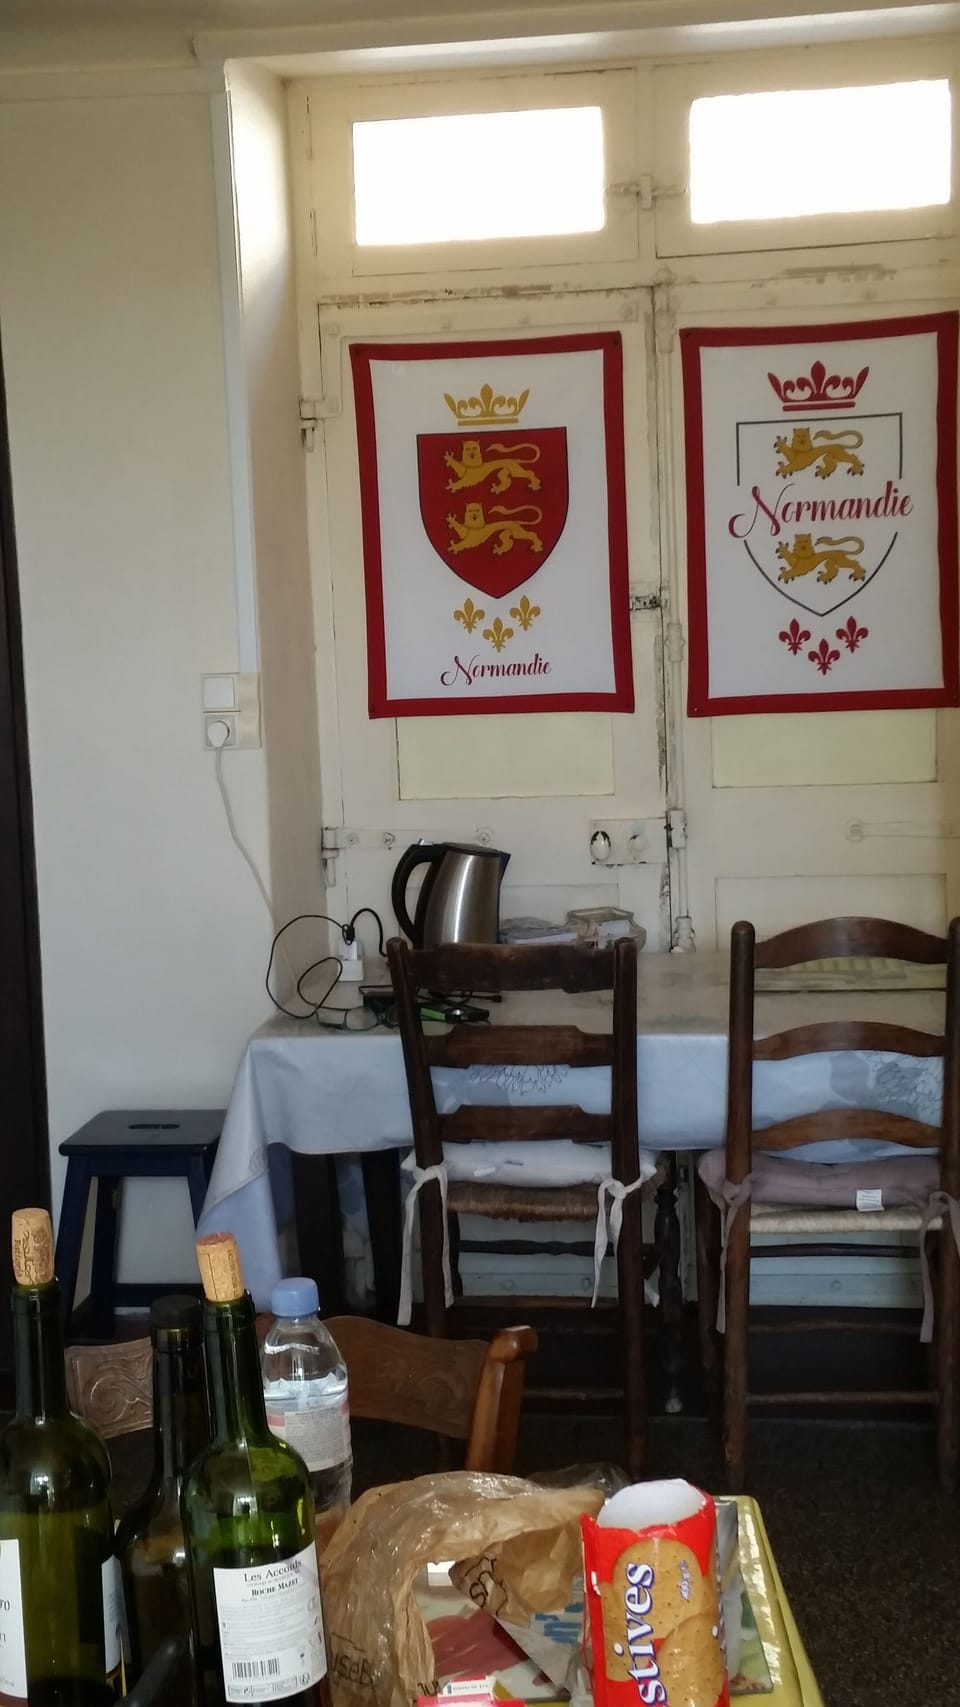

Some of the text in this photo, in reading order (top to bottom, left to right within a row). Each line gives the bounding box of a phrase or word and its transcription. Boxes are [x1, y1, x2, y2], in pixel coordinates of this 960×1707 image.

[728, 480, 914, 538] Normandie
[440, 653, 552, 686] Normandie
[244, 1573, 262, 1583] Les
[265, 1559, 302, 1579] Accords
[613, 1562, 668, 1707] stives
